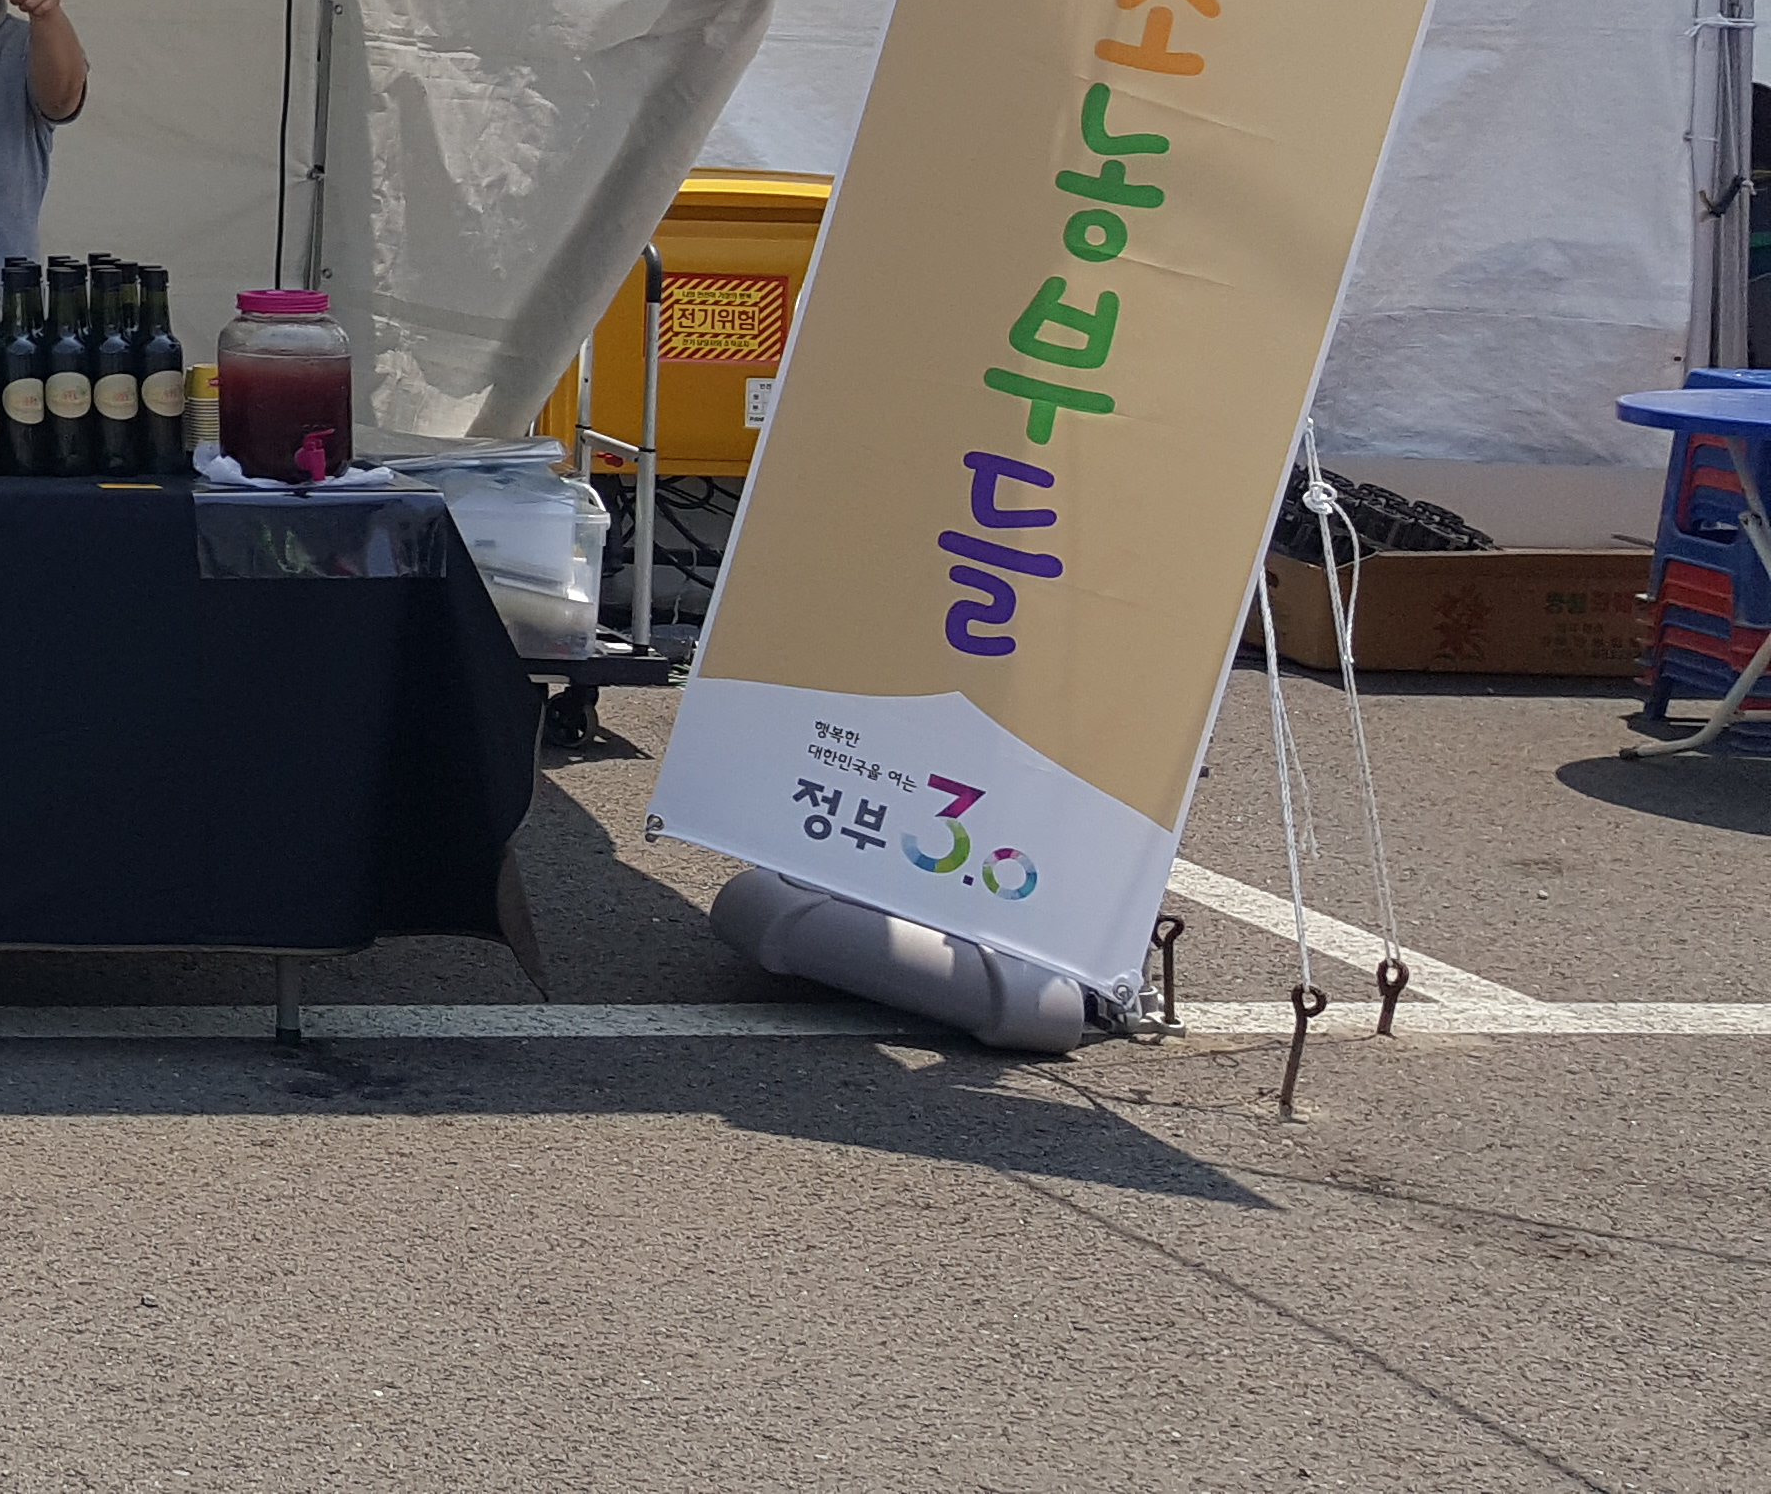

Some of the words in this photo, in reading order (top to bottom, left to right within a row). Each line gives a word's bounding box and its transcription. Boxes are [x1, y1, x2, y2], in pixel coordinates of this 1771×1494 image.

[677, 308, 756, 331] 전기위험
[814, 720, 860, 748] 행복한
[808, 744, 883, 781] 대한민국을
[888, 770, 917, 793] 여는
[792, 777, 889, 852] 정부
[900, 772, 1038, 901] 3.0
